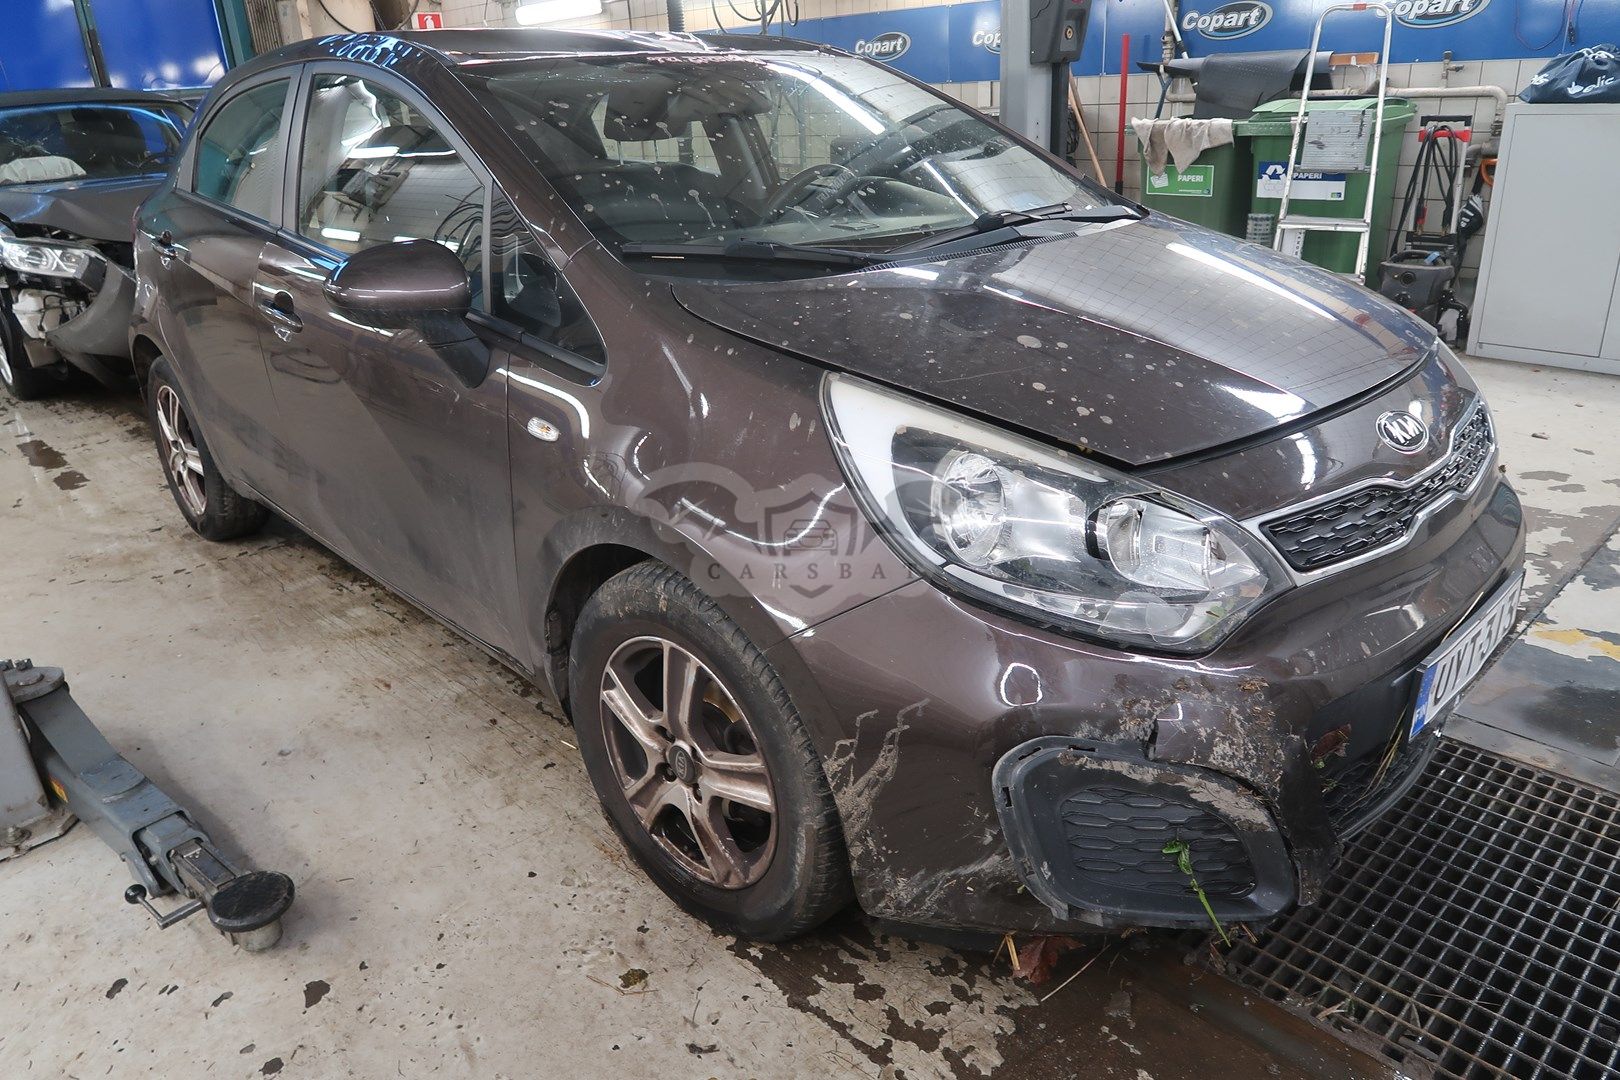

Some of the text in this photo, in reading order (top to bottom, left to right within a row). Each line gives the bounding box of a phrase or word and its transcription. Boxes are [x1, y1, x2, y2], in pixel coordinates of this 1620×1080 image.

[1182, 7, 1261, 33] Copart
[855, 37, 904, 56] Copart
[972, 30, 1001, 47] Cop
[1177, 174, 1204, 182] PAPERI
[1293, 172, 1323, 180] PAPERI
